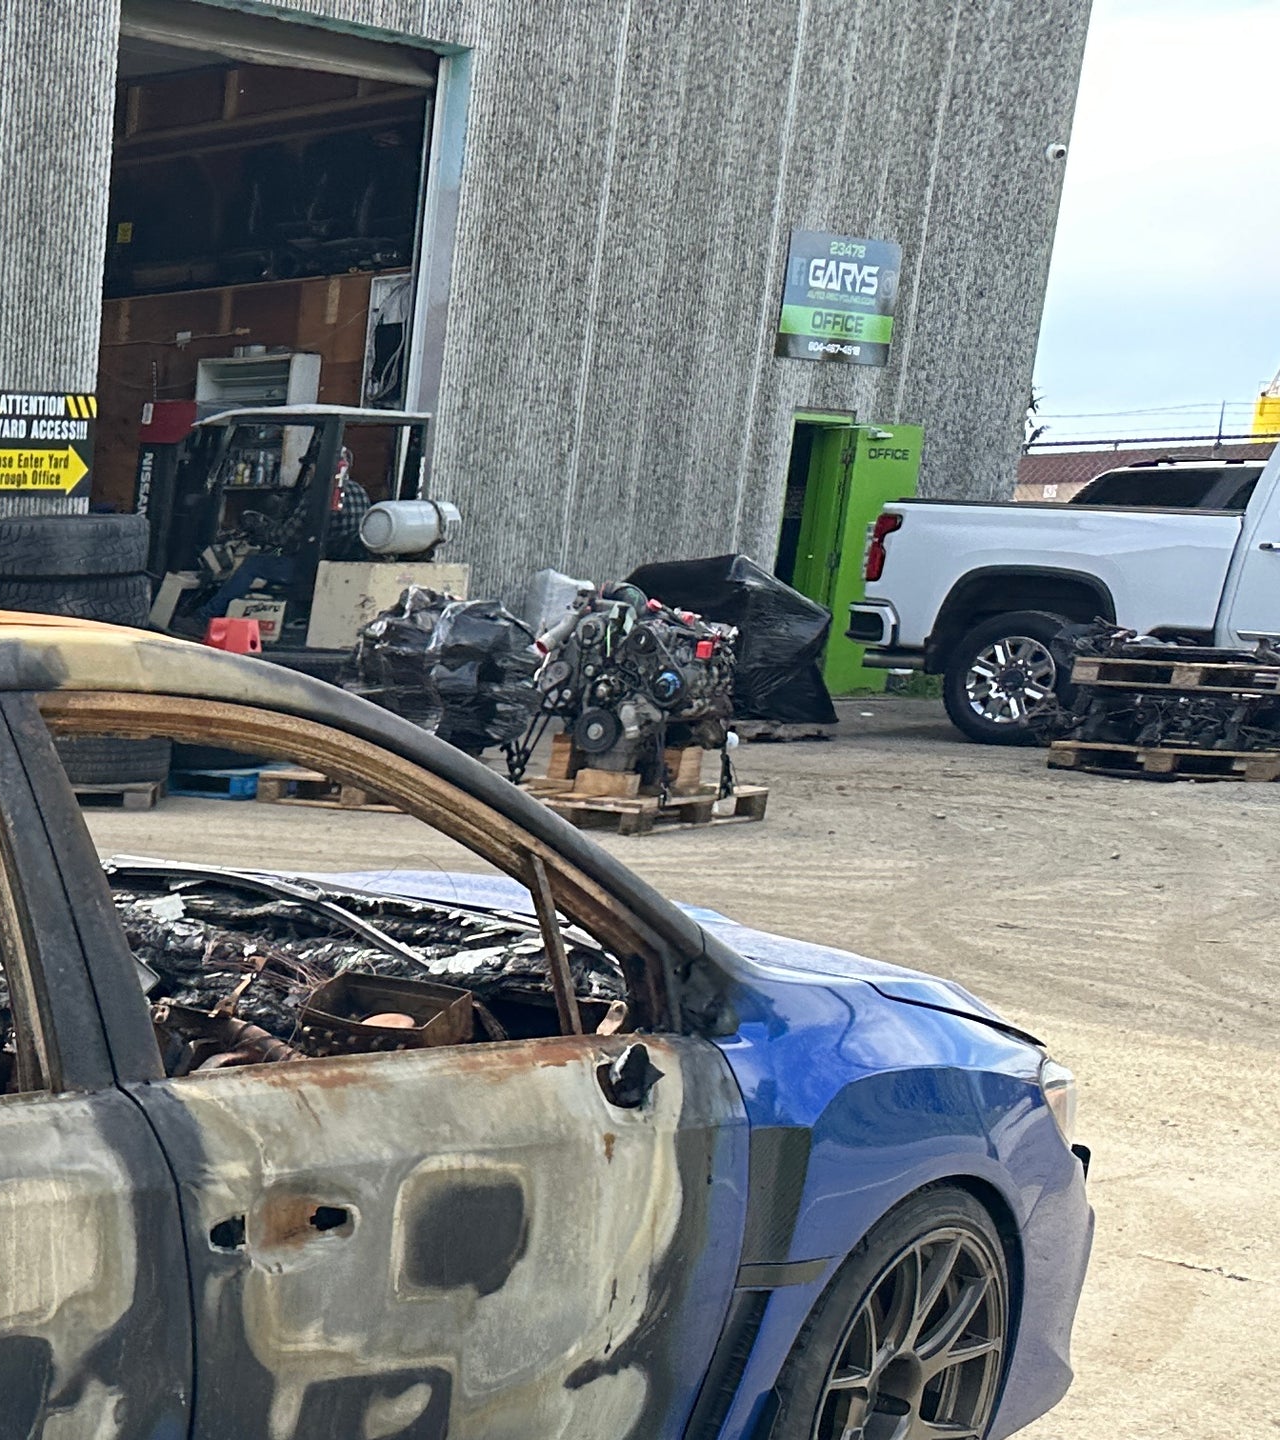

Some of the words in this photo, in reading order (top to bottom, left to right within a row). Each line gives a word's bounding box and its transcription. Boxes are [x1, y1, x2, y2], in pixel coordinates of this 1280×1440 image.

[830, 241, 867, 259] 23478
[808, 258, 880, 295] GARYS
[811, 311, 865, 334] OFFICE
[30, 420, 88, 441] ACCESS!!!
[17, 453, 44, 469] Enter
[48, 454, 69, 469] Yard
[867, 448, 910, 461] OFFICE
[31, 470, 61, 485] Office
